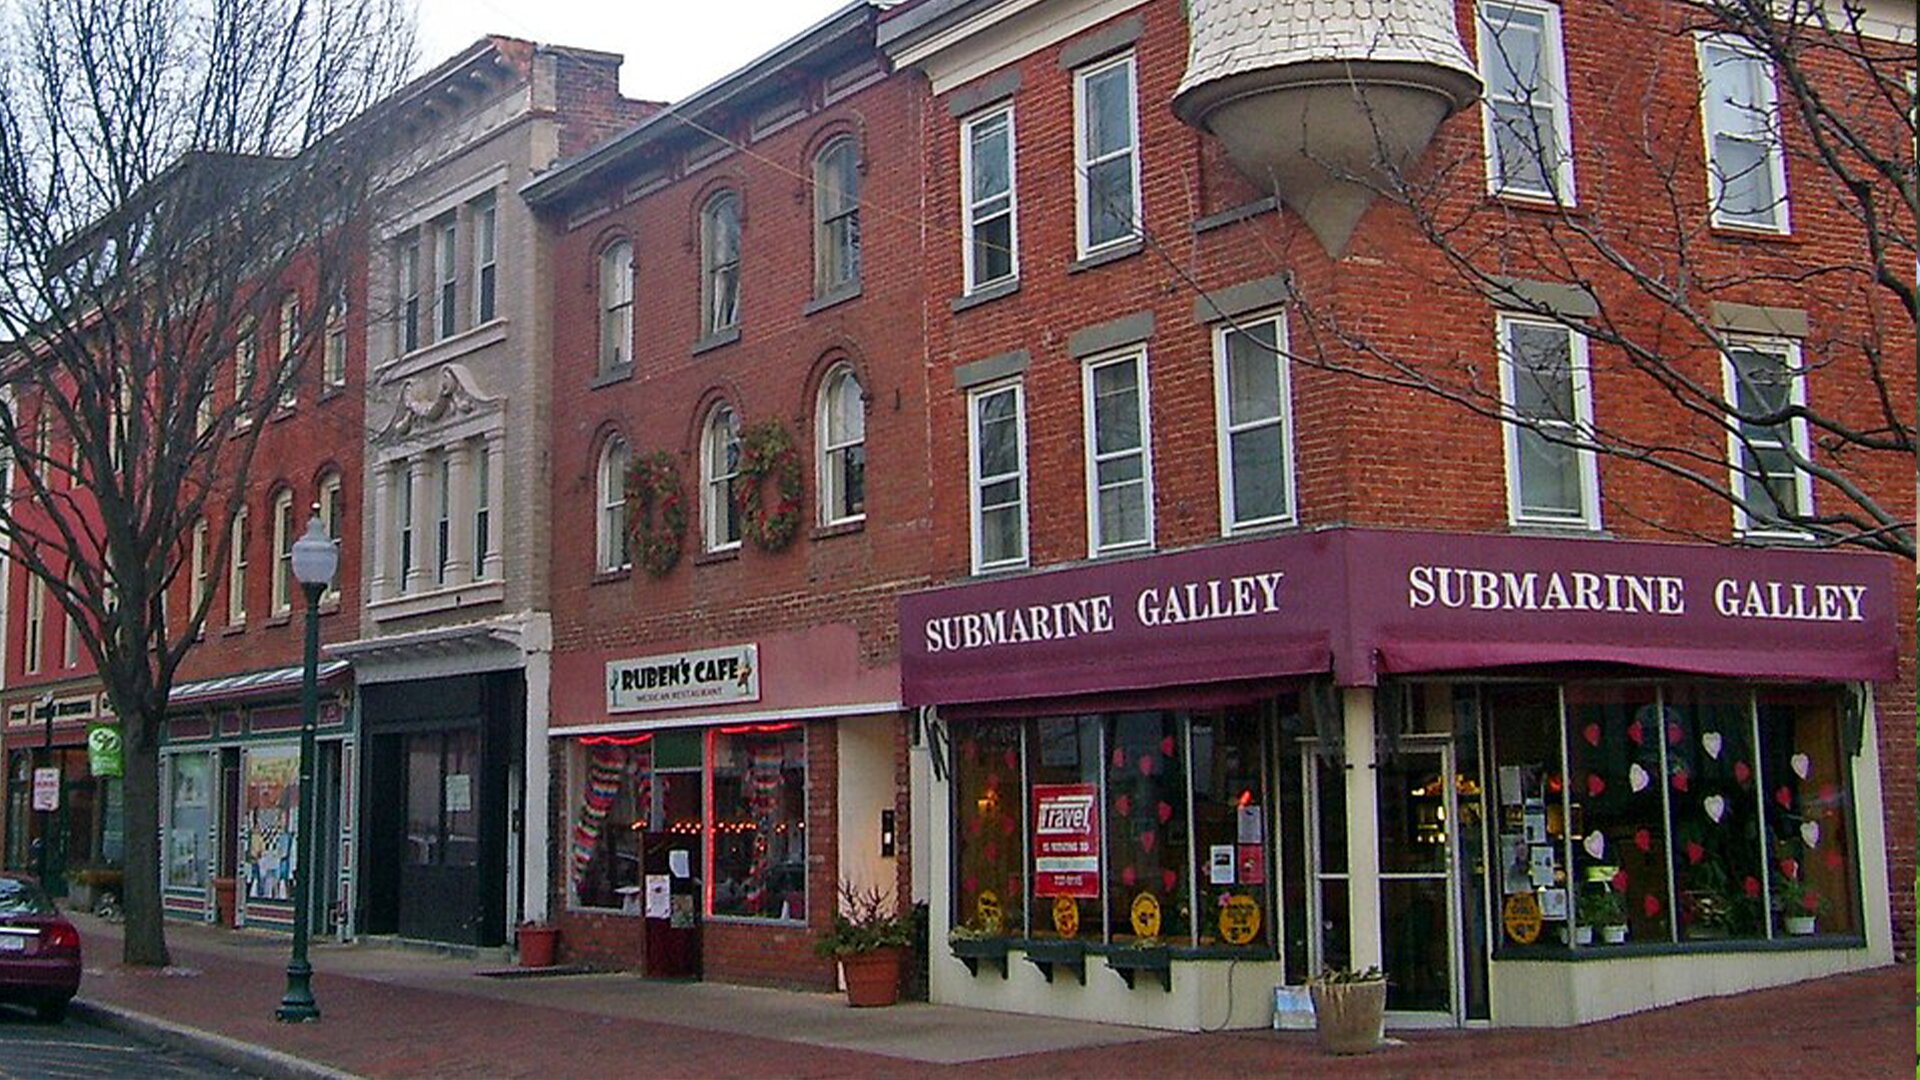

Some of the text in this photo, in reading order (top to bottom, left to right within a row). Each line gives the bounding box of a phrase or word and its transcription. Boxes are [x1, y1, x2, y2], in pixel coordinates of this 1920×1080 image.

[926, 572, 1284, 652] SUBMARINE GALLEY
[1409, 566, 1868, 622] SUBMARINE GALLEY
[621, 656, 739, 691] RUBEN'S CAFE
